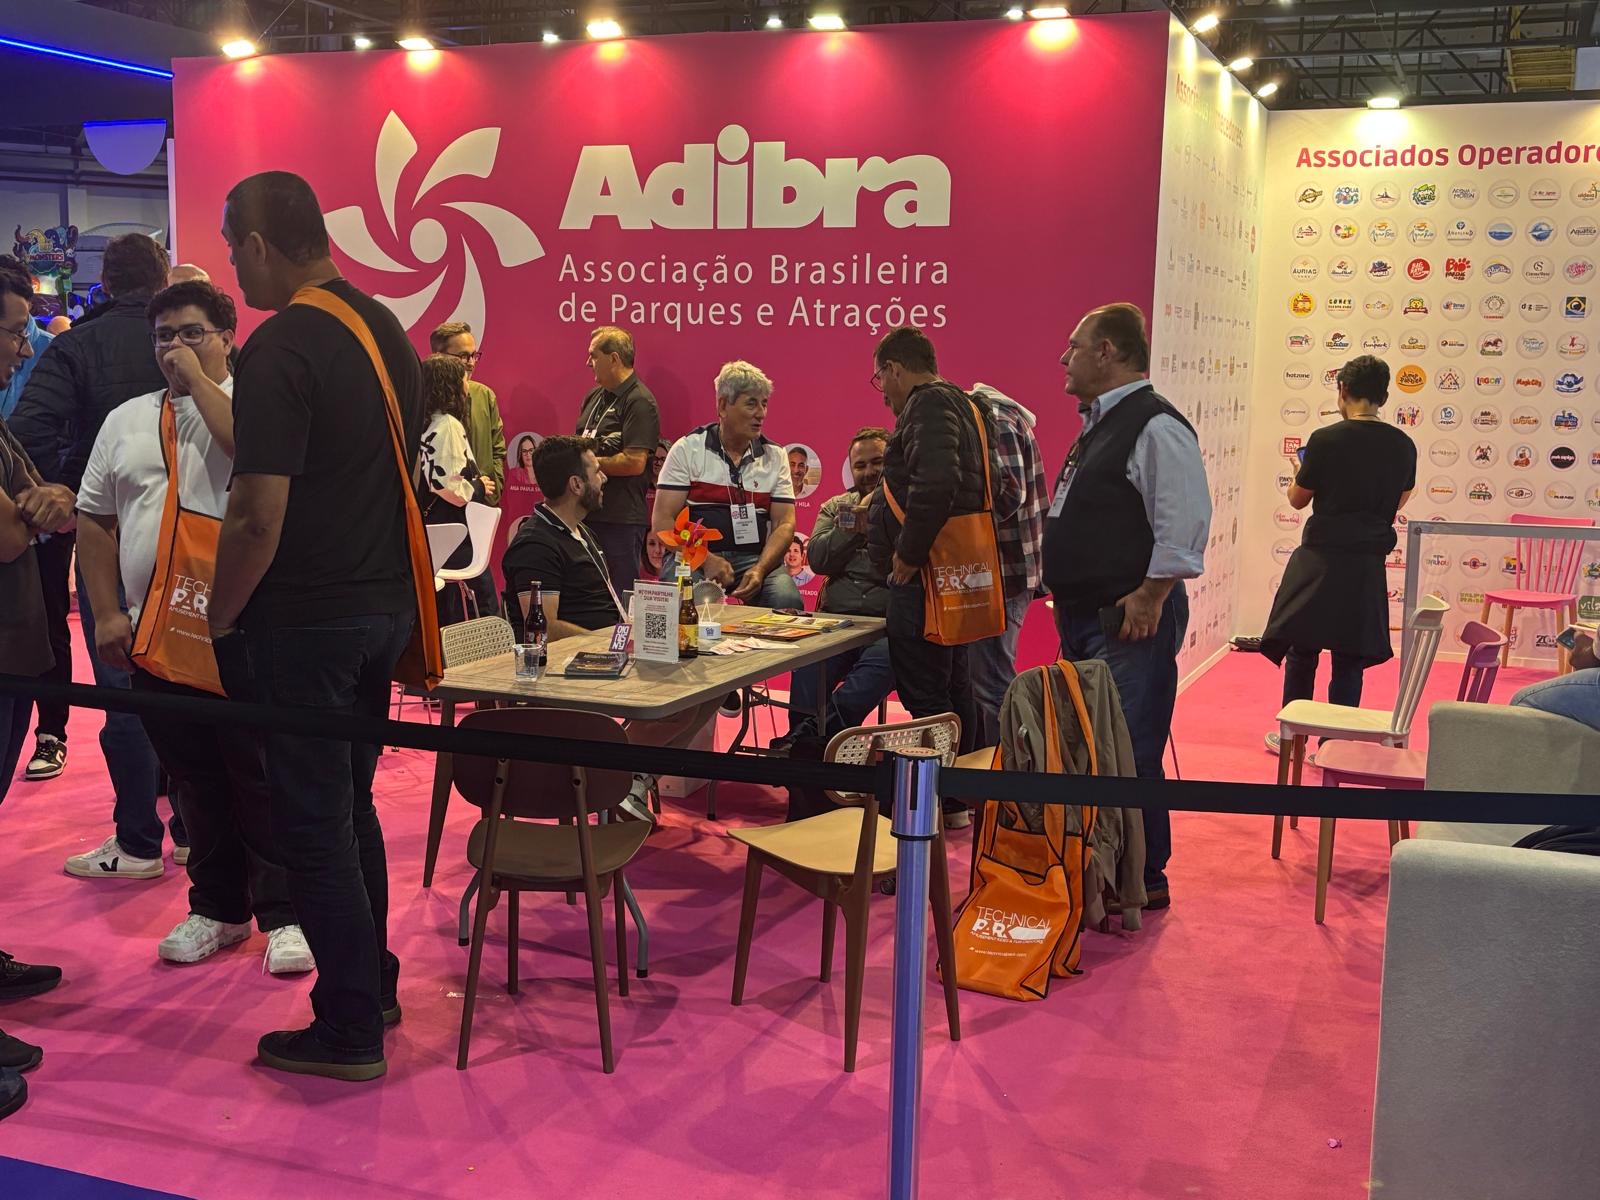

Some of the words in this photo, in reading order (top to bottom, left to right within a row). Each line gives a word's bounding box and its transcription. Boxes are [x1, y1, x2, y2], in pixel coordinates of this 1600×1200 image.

[1296, 144, 1449, 168] Associados
[558, 124, 951, 230] Adibra
[558, 254, 754, 291] Associação
[769, 253, 949, 285] Brasileira
[558, 292, 597, 323] de
[610, 294, 742, 332] Parques
[756, 303, 774, 326] e
[788, 295, 948, 335] Atrações
[933, 562, 992, 577] TECHNICAL
[175, 574, 212, 595] TECH
[170, 588, 209, 616] PAR
[976, 905, 1051, 929] TECHNICAL
